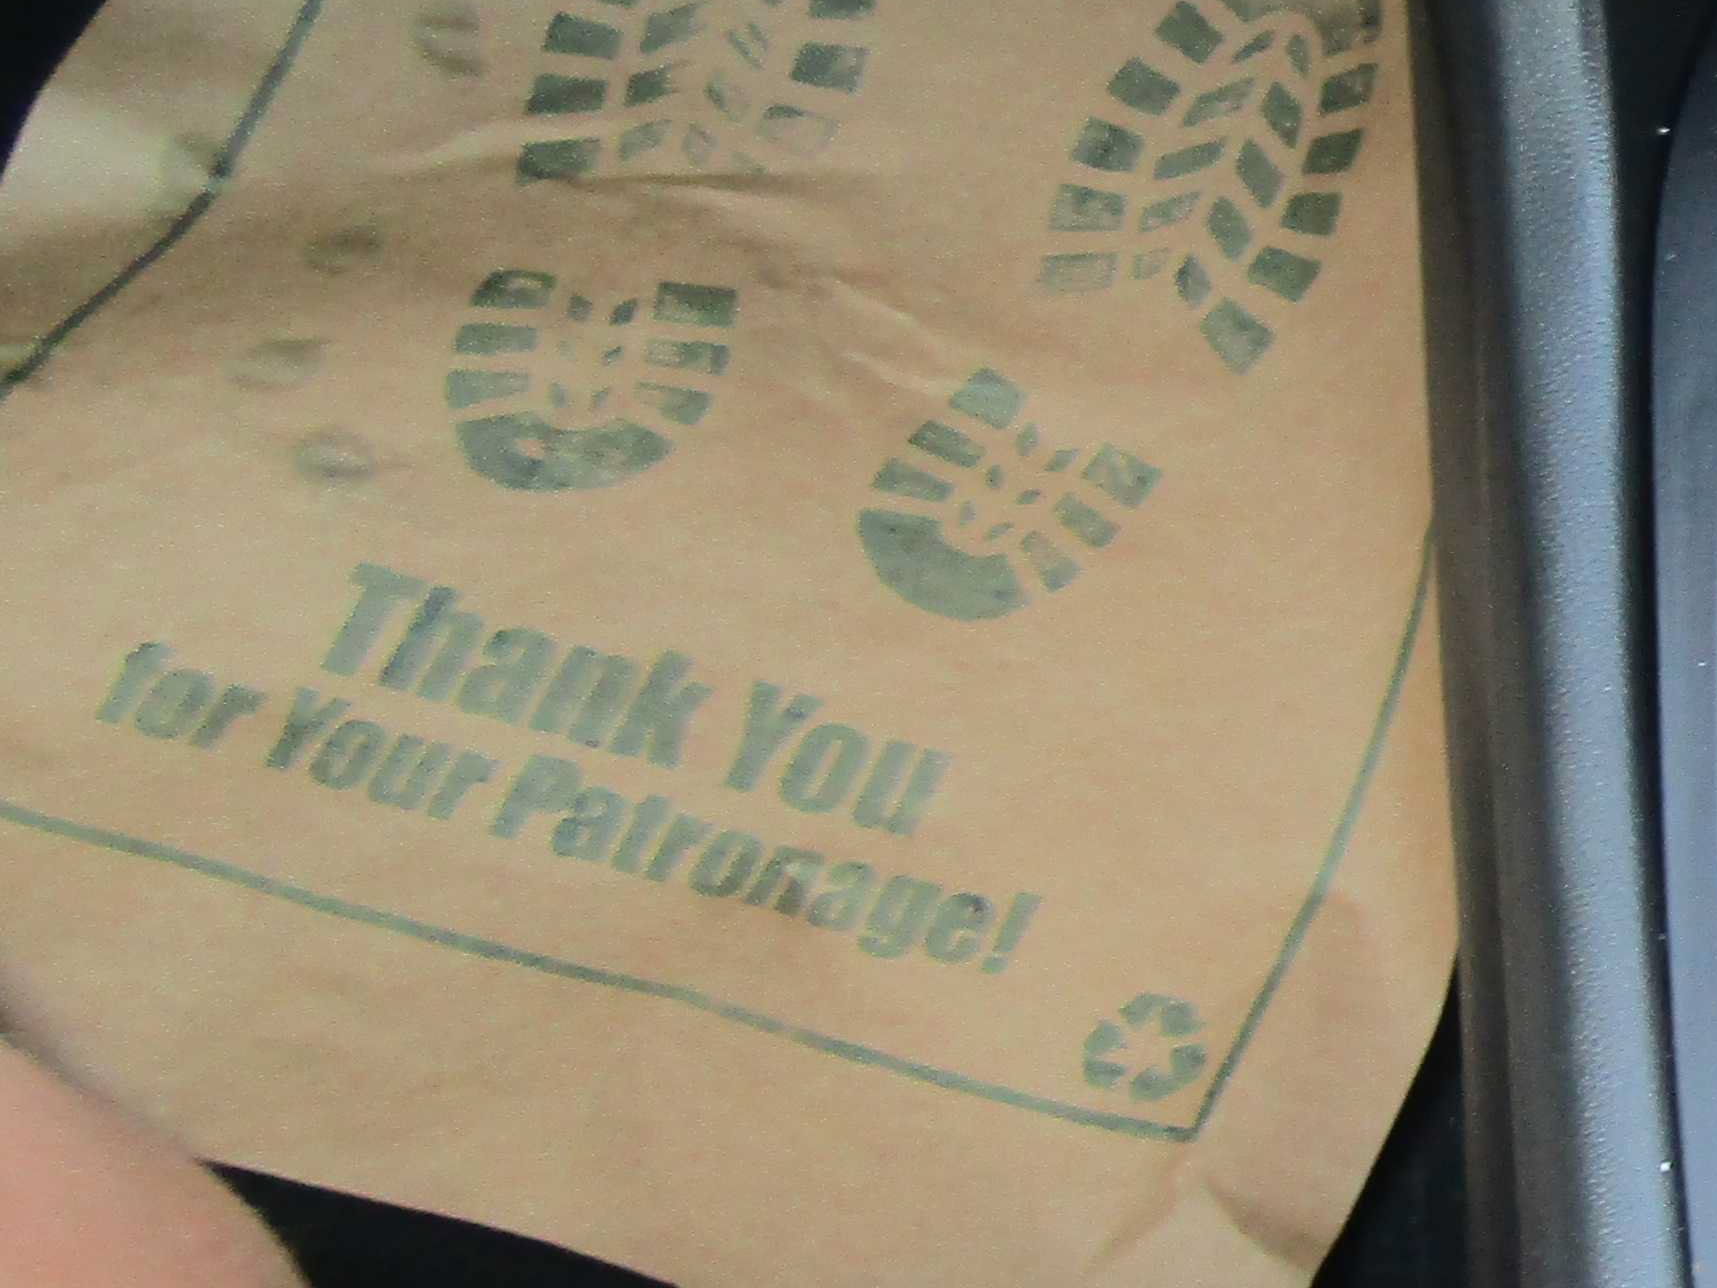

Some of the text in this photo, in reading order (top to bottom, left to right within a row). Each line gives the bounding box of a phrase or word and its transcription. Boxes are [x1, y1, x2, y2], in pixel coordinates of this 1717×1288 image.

[93, 640, 1041, 974] for Your Patronage!
[321, 561, 950, 837] Thank You
